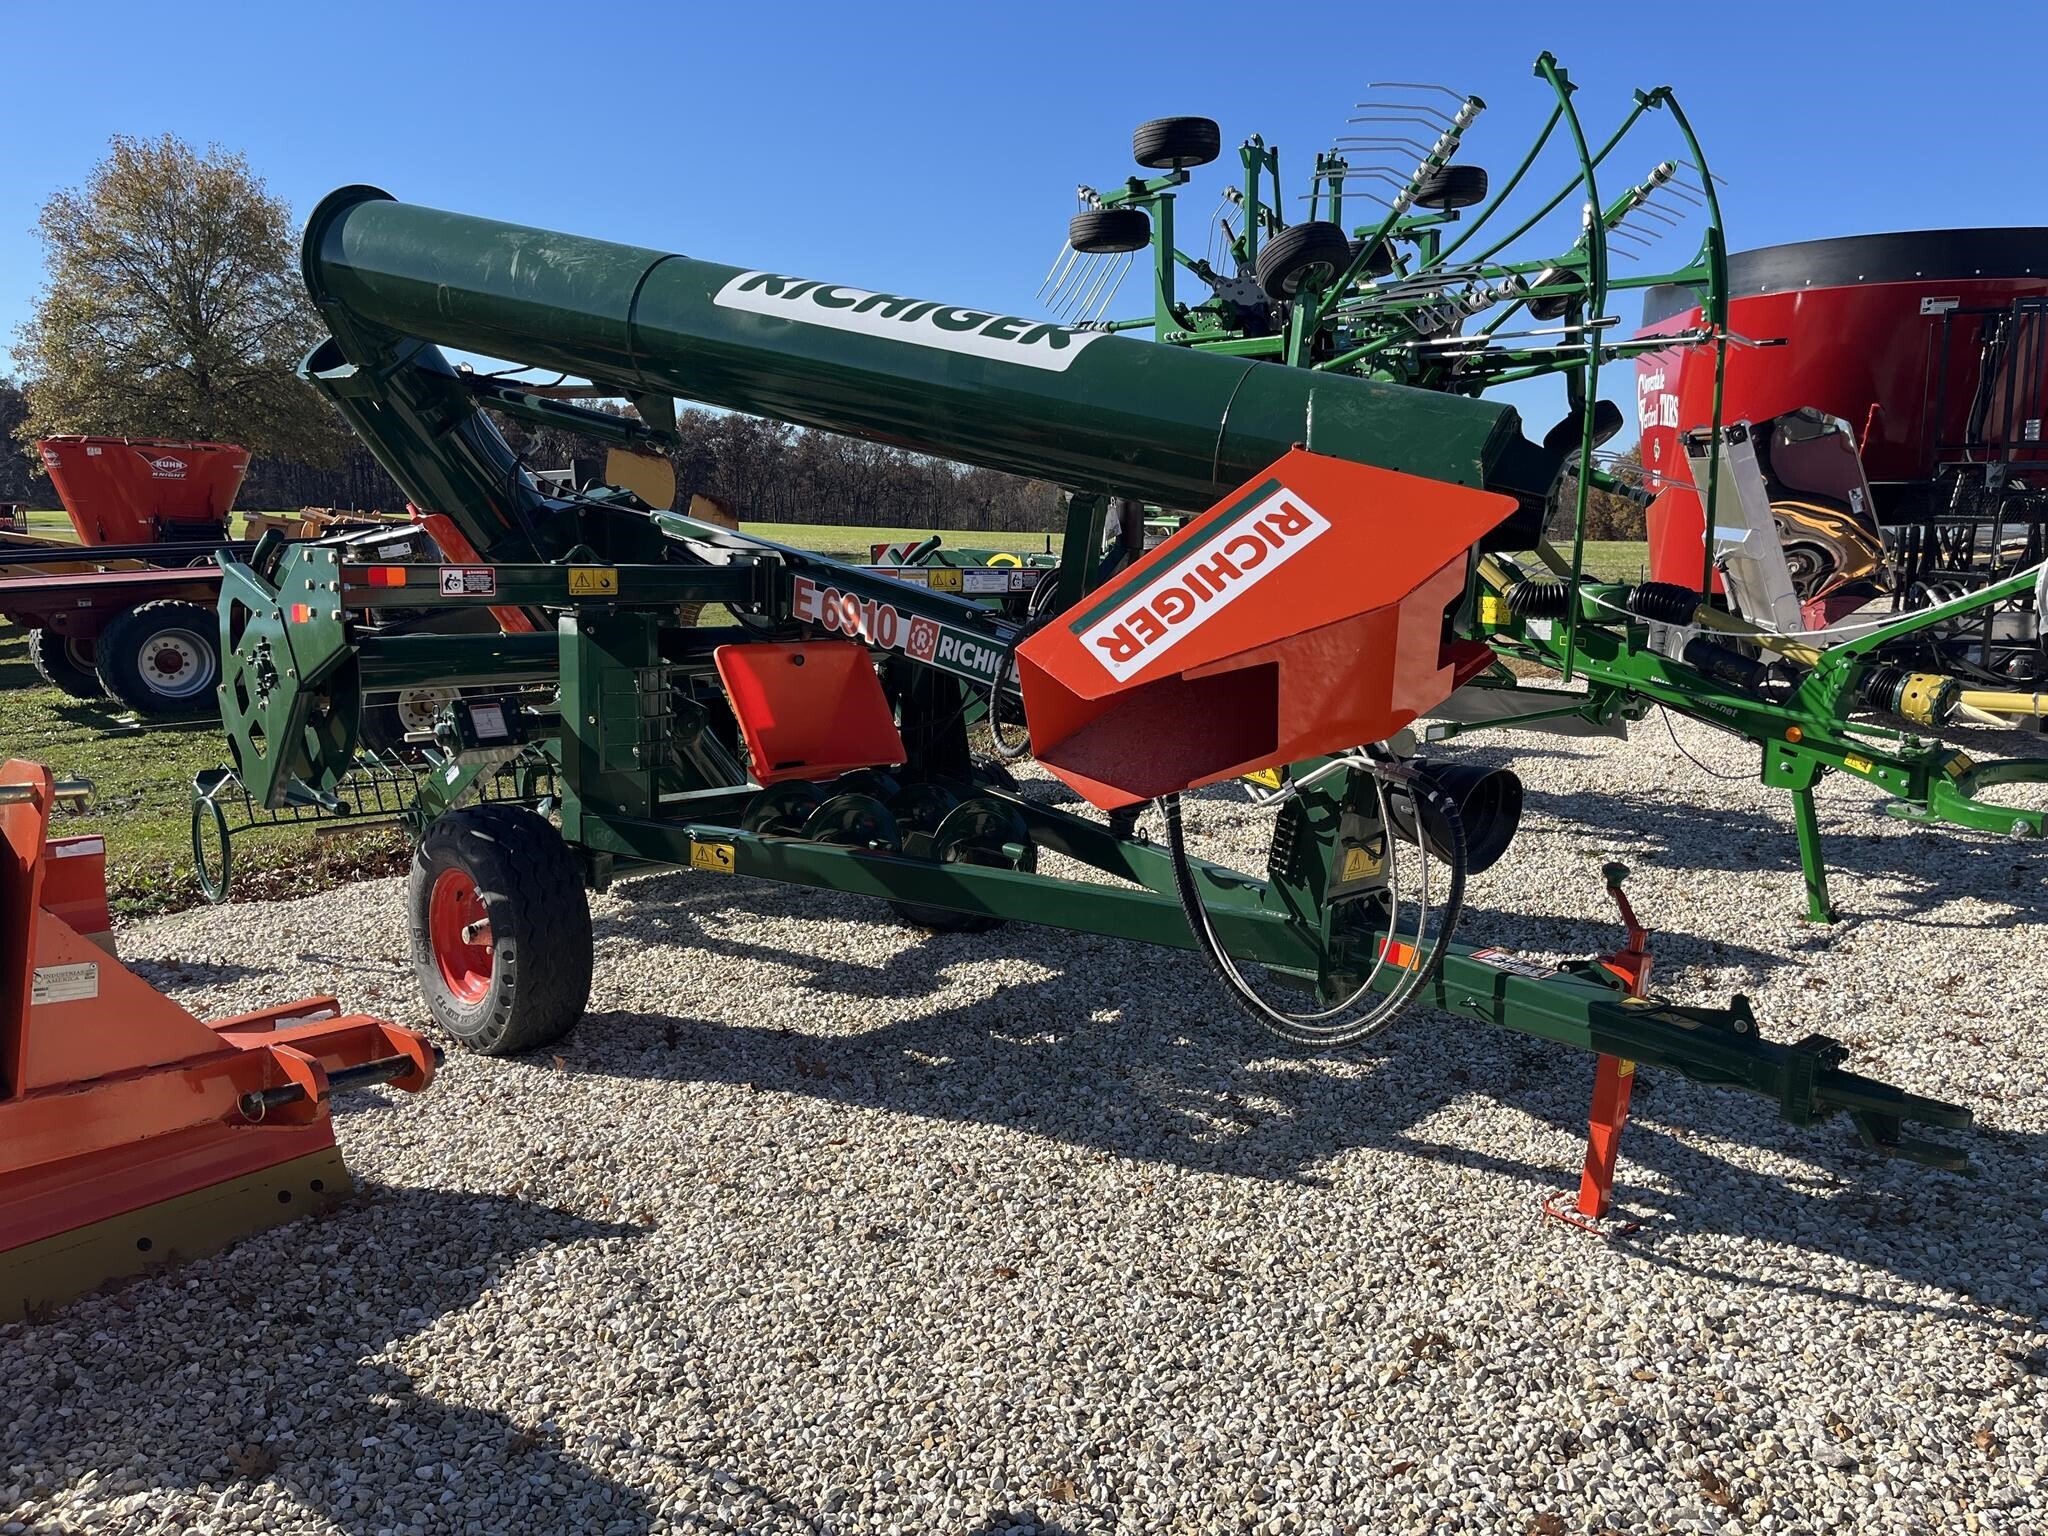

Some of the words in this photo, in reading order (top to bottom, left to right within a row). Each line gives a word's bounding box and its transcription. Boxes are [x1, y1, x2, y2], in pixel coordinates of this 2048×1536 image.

[738, 273, 1079, 350] RICHIGER
[1659, 393, 1679, 428] TMRS
[156, 461, 183, 469] KUHN
[793, 576, 816, 623] E
[821, 587, 898, 649] 6910
[1096, 501, 1314, 663] RICHIGER
